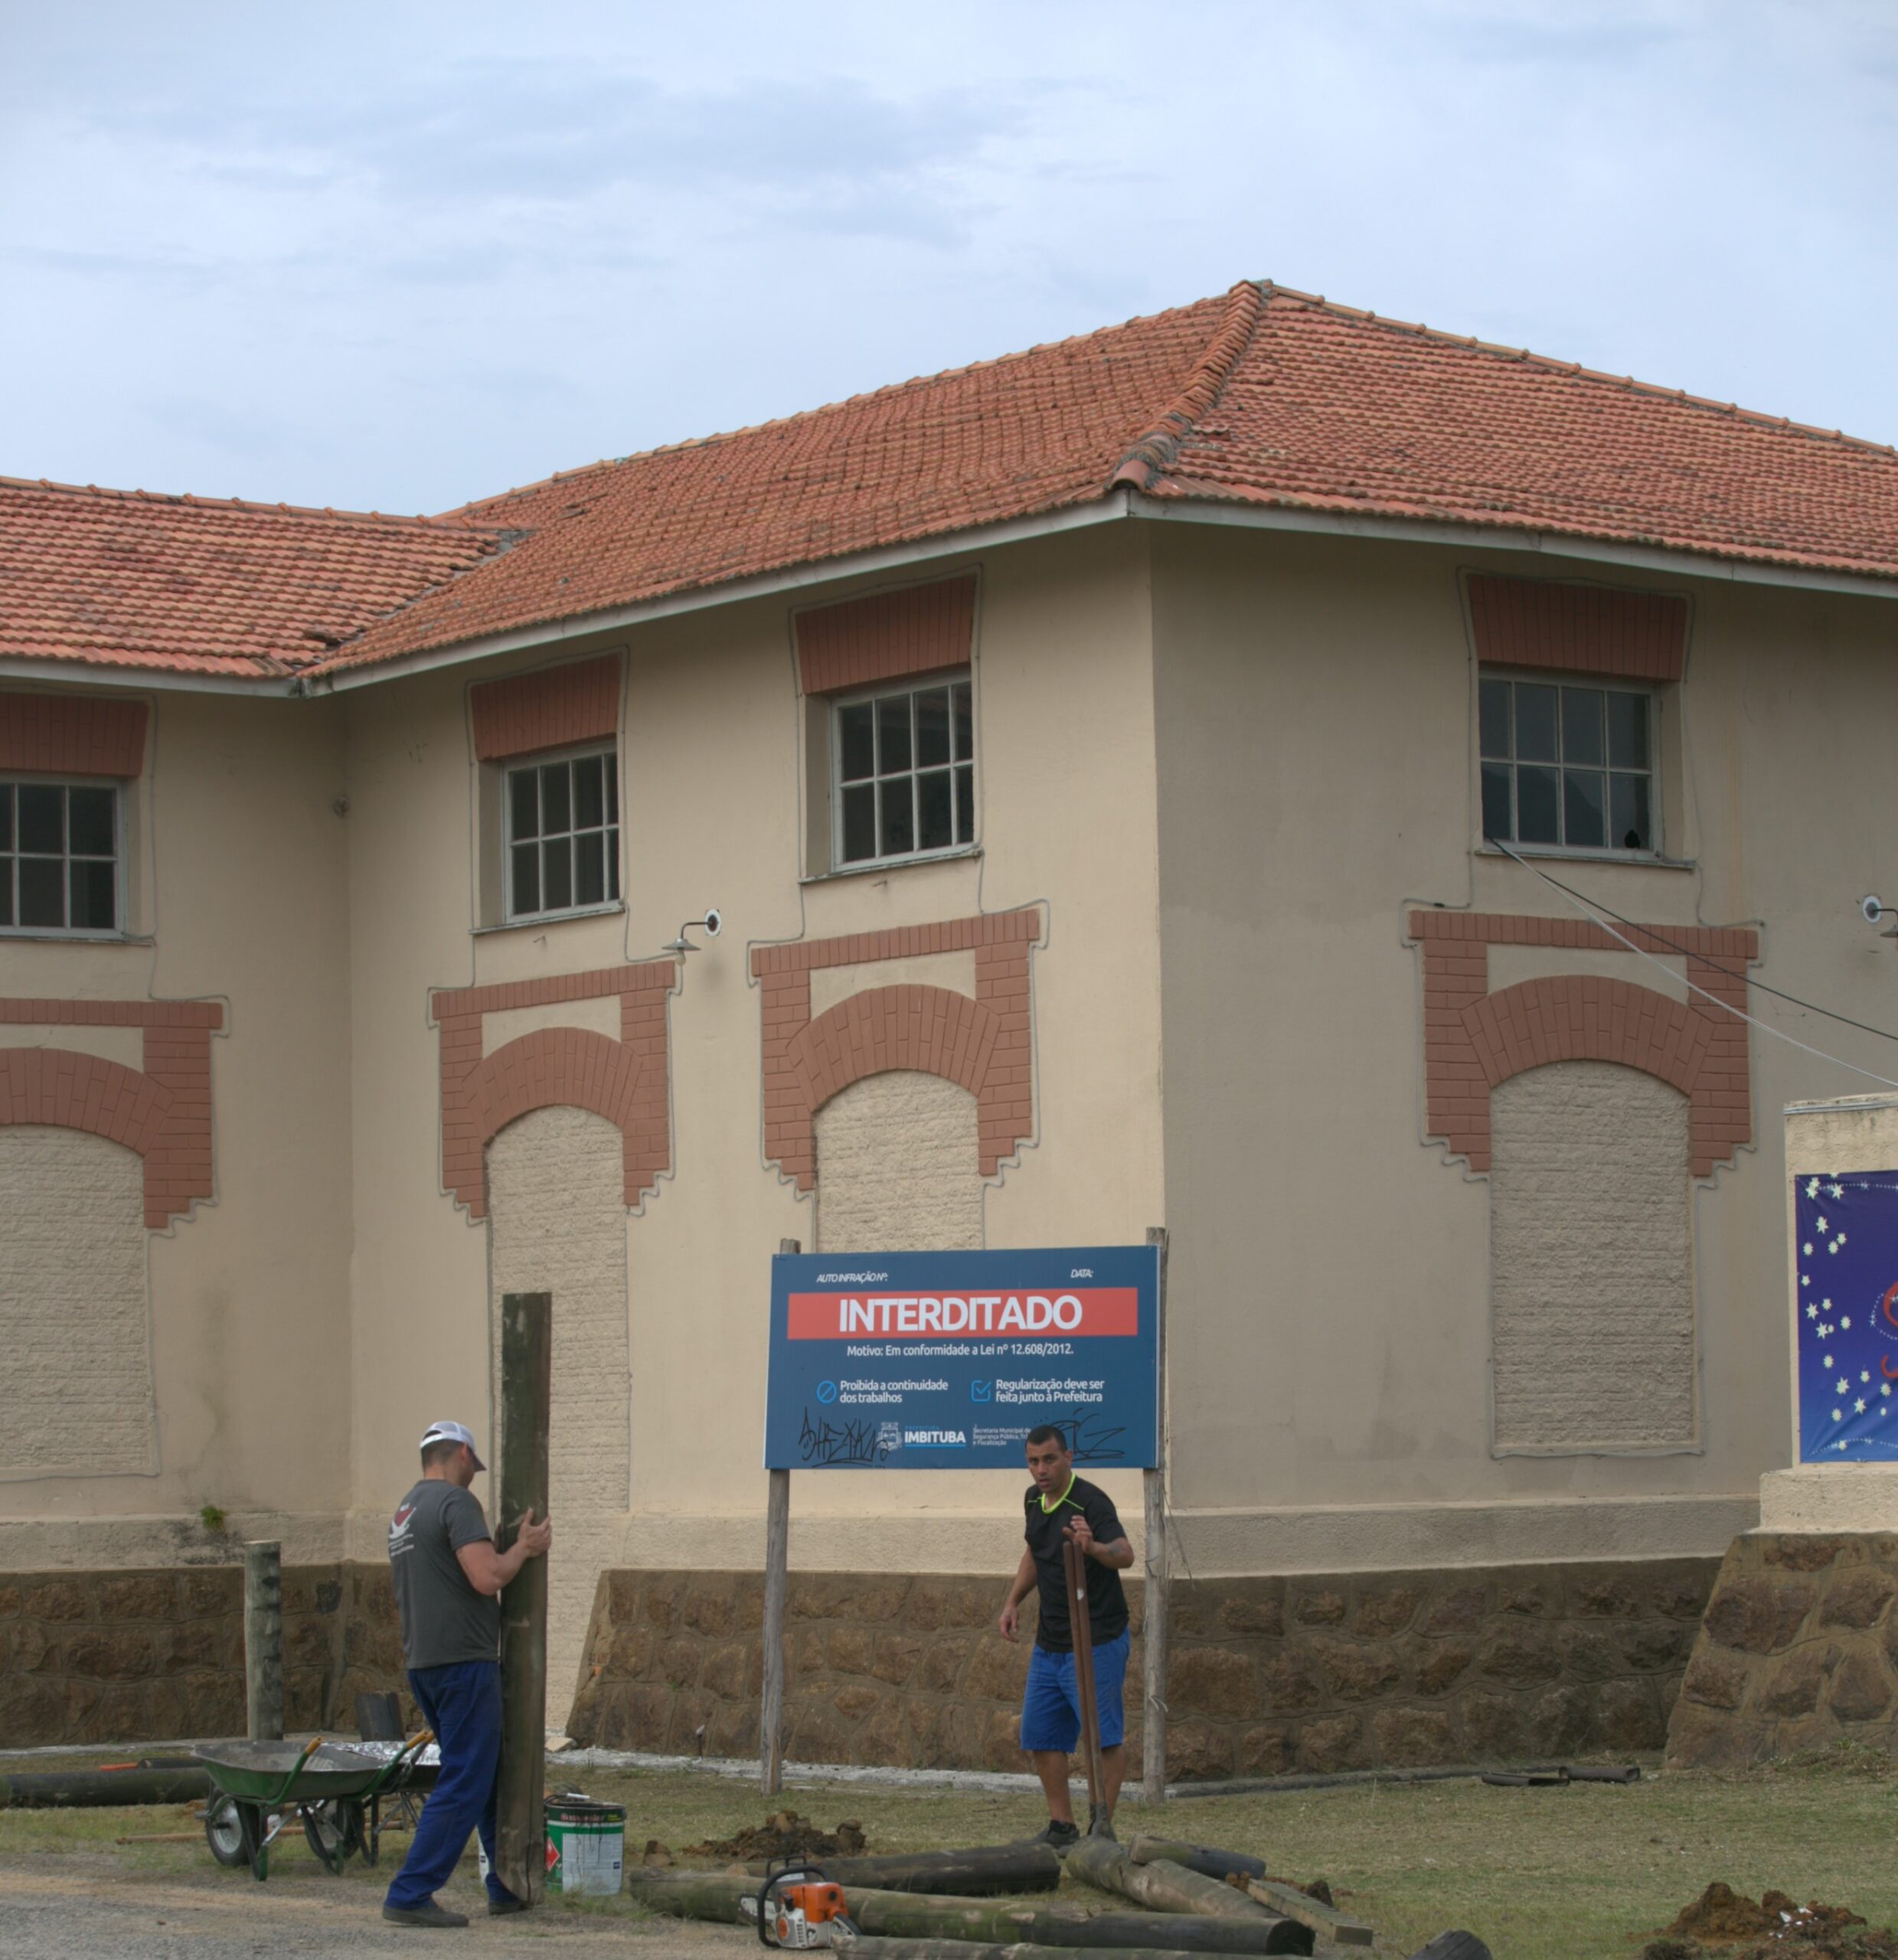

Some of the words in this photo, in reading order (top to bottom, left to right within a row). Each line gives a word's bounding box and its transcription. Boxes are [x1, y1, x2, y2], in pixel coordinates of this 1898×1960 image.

[816, 1274, 838, 1283] AUTO
[838, 1270, 877, 1284] INFRAÇÃO
[1070, 1269, 1093, 1278] DATA:
[839, 1295, 1083, 1332] INTERDITADO
[847, 1344, 883, 1357] Motivo:
[886, 1345, 901, 1356] Em
[903, 1344, 970, 1356] conformidade
[980, 1344, 995, 1355] Lei
[997, 1344, 1008, 1355] nº
[1011, 1343, 1074, 1357] 12.608/2012.
[840, 1380, 878, 1390] Proibida
[887, 1379, 949, 1390] continuidade
[996, 1378, 1063, 1393] Regularização
[1063, 1378, 1088, 1390] deve
[1089, 1380, 1105, 1390] ser
[840, 1392, 857, 1403] dos
[858, 1392, 903, 1403] trabalhos
[996, 1391, 1018, 1402] feita
[1018, 1391, 1044, 1404] junto
[1054, 1390, 1103, 1402] Prefeitura
[904, 1431, 966, 1443] IMBITUBA
